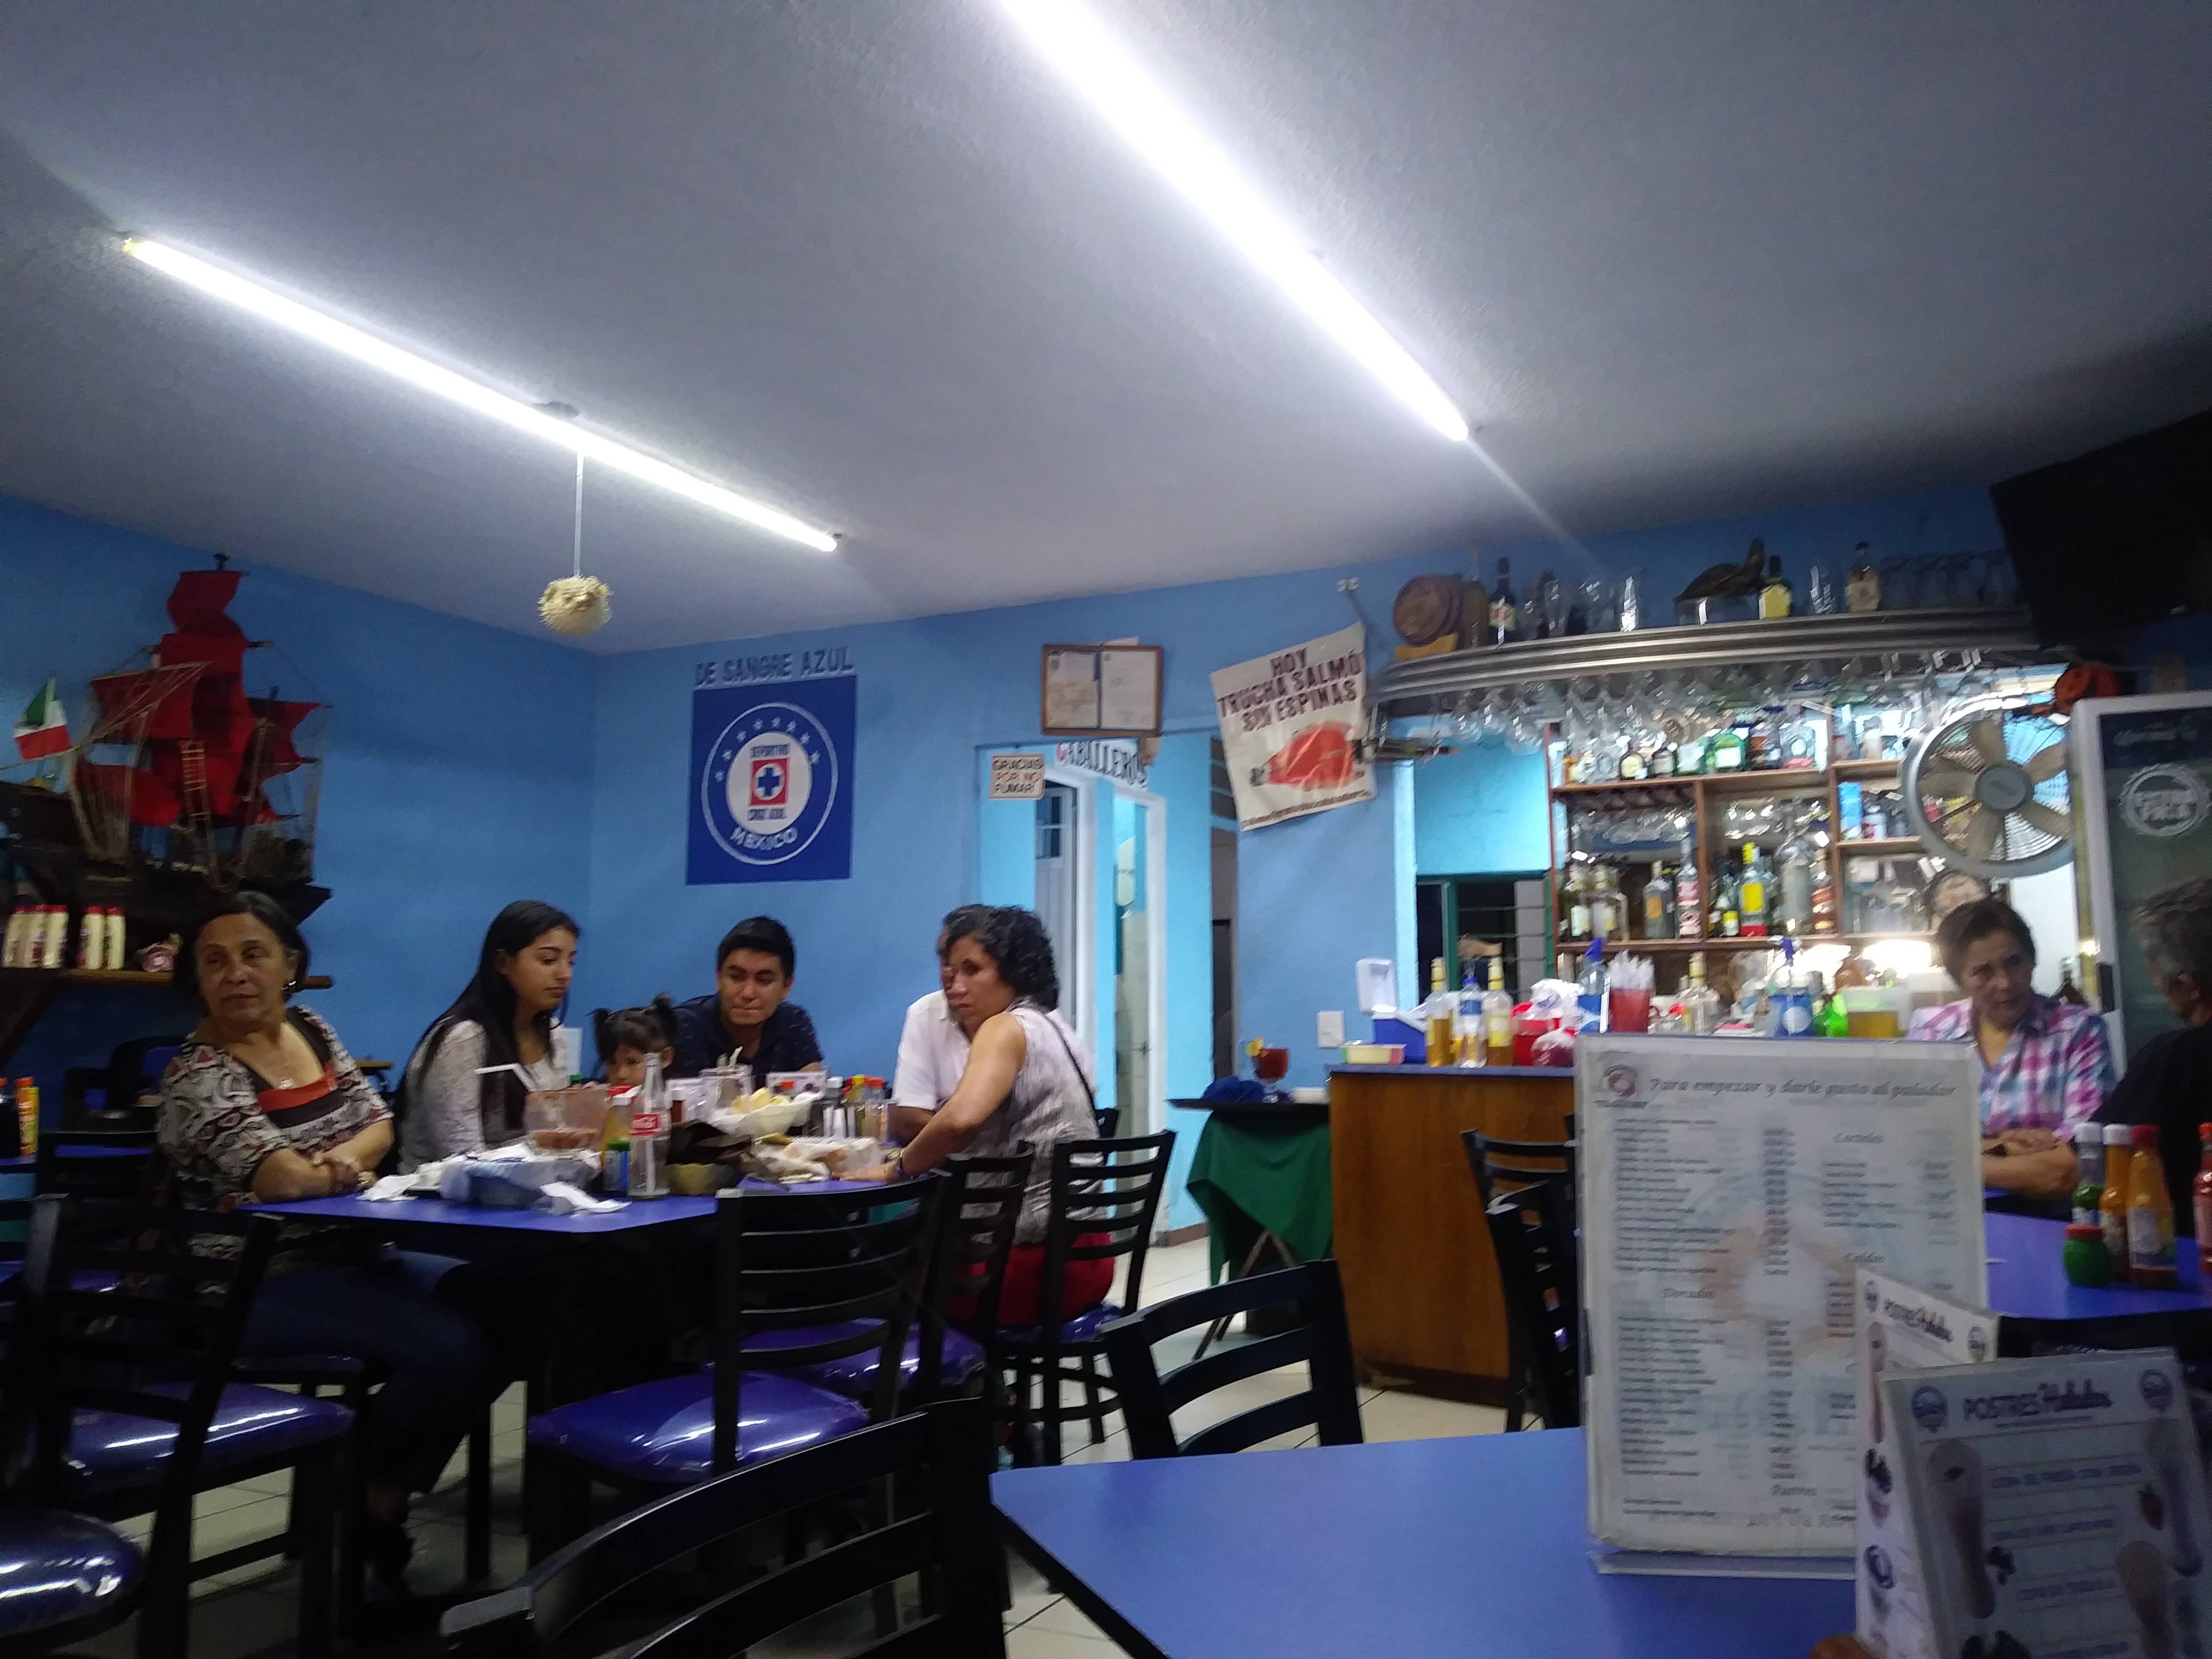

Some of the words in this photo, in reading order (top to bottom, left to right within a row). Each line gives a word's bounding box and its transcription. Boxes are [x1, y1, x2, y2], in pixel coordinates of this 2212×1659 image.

[695, 661, 717, 685] DE
[723, 652, 793, 682] SANGRE
[801, 646, 854, 675] AZUL
[1269, 647, 1308, 678] HOY
[1218, 676, 1288, 718] TRUCHA
[1275, 680, 1357, 723] ESPINAS
[993, 758, 1044, 772] GRACIAS
[994, 783, 1036, 794] FUMAR
